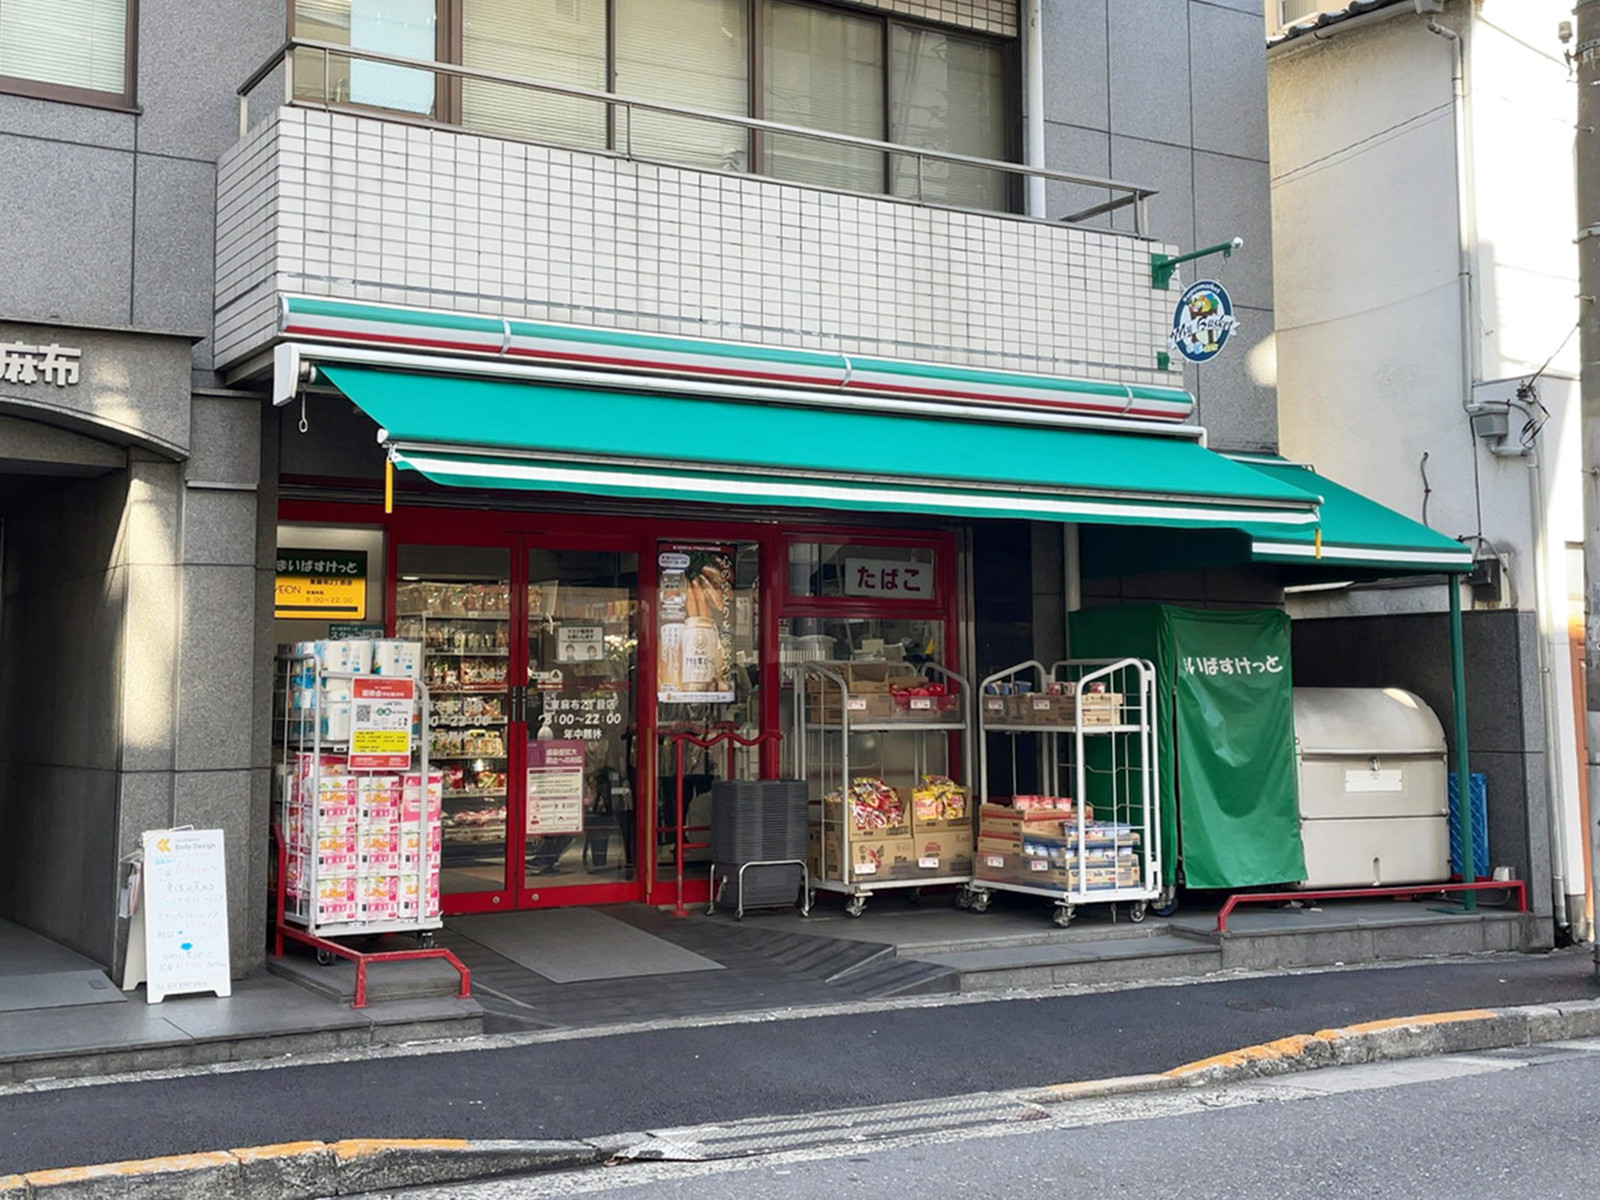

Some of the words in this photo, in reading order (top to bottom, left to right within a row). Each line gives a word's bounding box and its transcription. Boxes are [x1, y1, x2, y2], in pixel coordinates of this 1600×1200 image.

[0, 340, 82, 386] 麻布
[276, 559, 358, 574] まいばすけっと
[857, 566, 921, 592] たばこ
[563, 728, 602, 740] 年中無休
